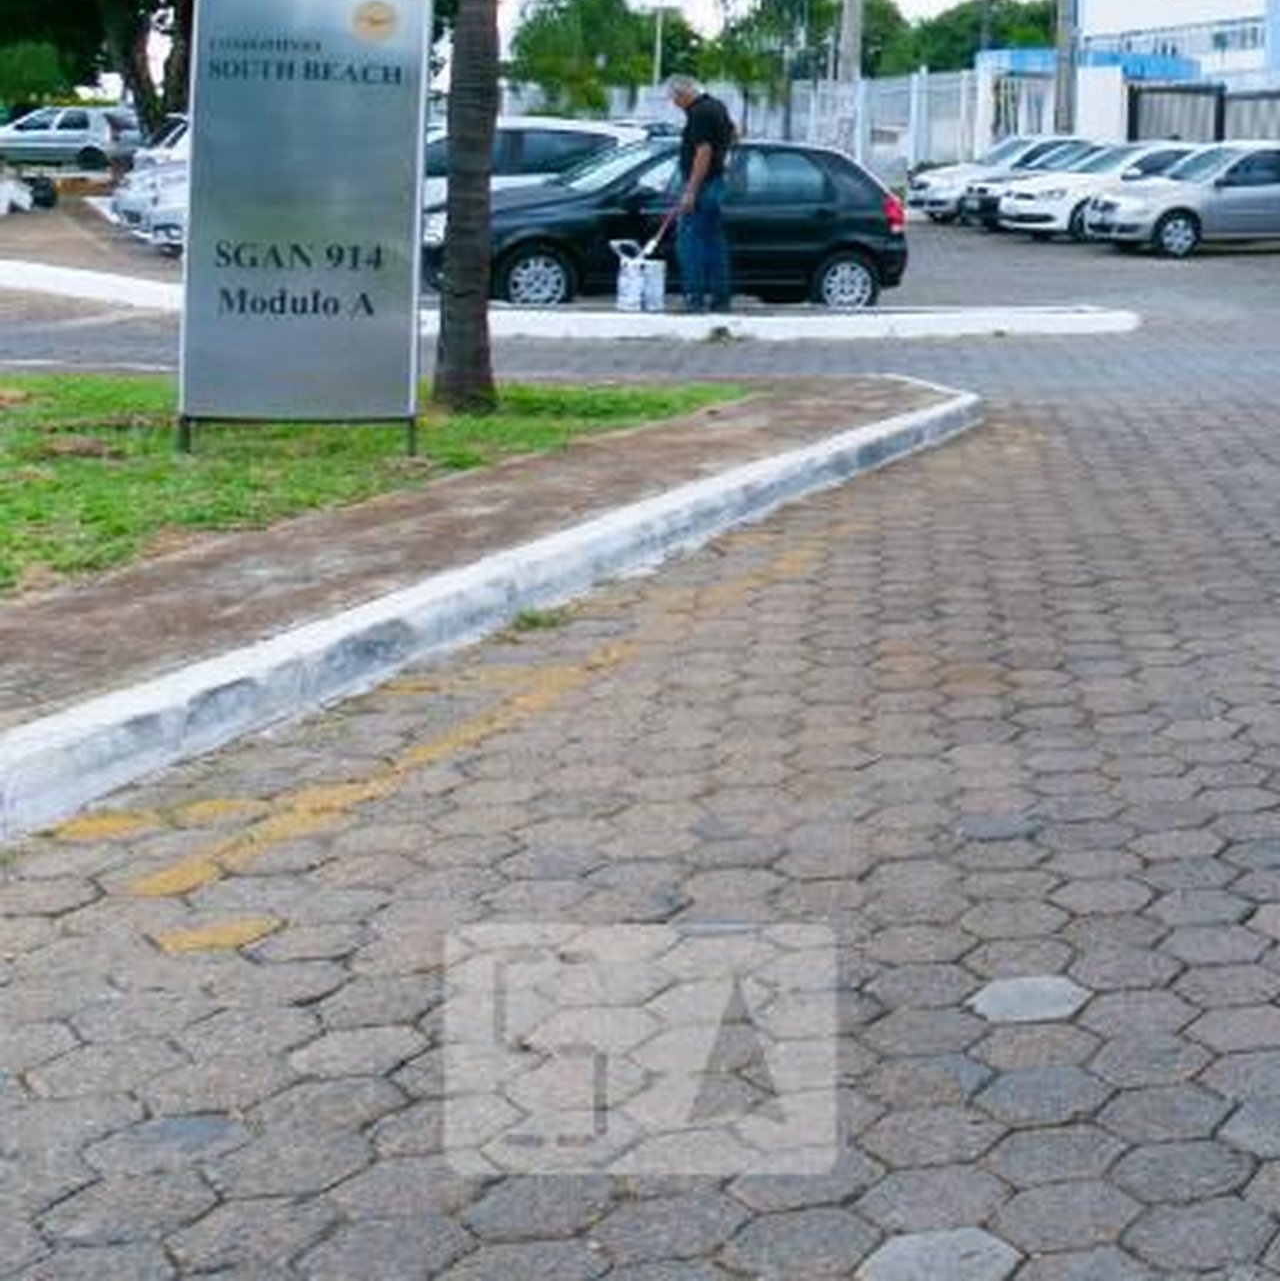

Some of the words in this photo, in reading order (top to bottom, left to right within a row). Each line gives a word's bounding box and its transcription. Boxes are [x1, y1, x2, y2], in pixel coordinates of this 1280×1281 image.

[209, 59, 295, 81] SOUTH
[303, 61, 402, 85] BEACH
[215, 240, 312, 269] SGAN
[326, 244, 382, 272] 914
[218, 287, 341, 316] Modulo
[350, 292, 375, 317] A
